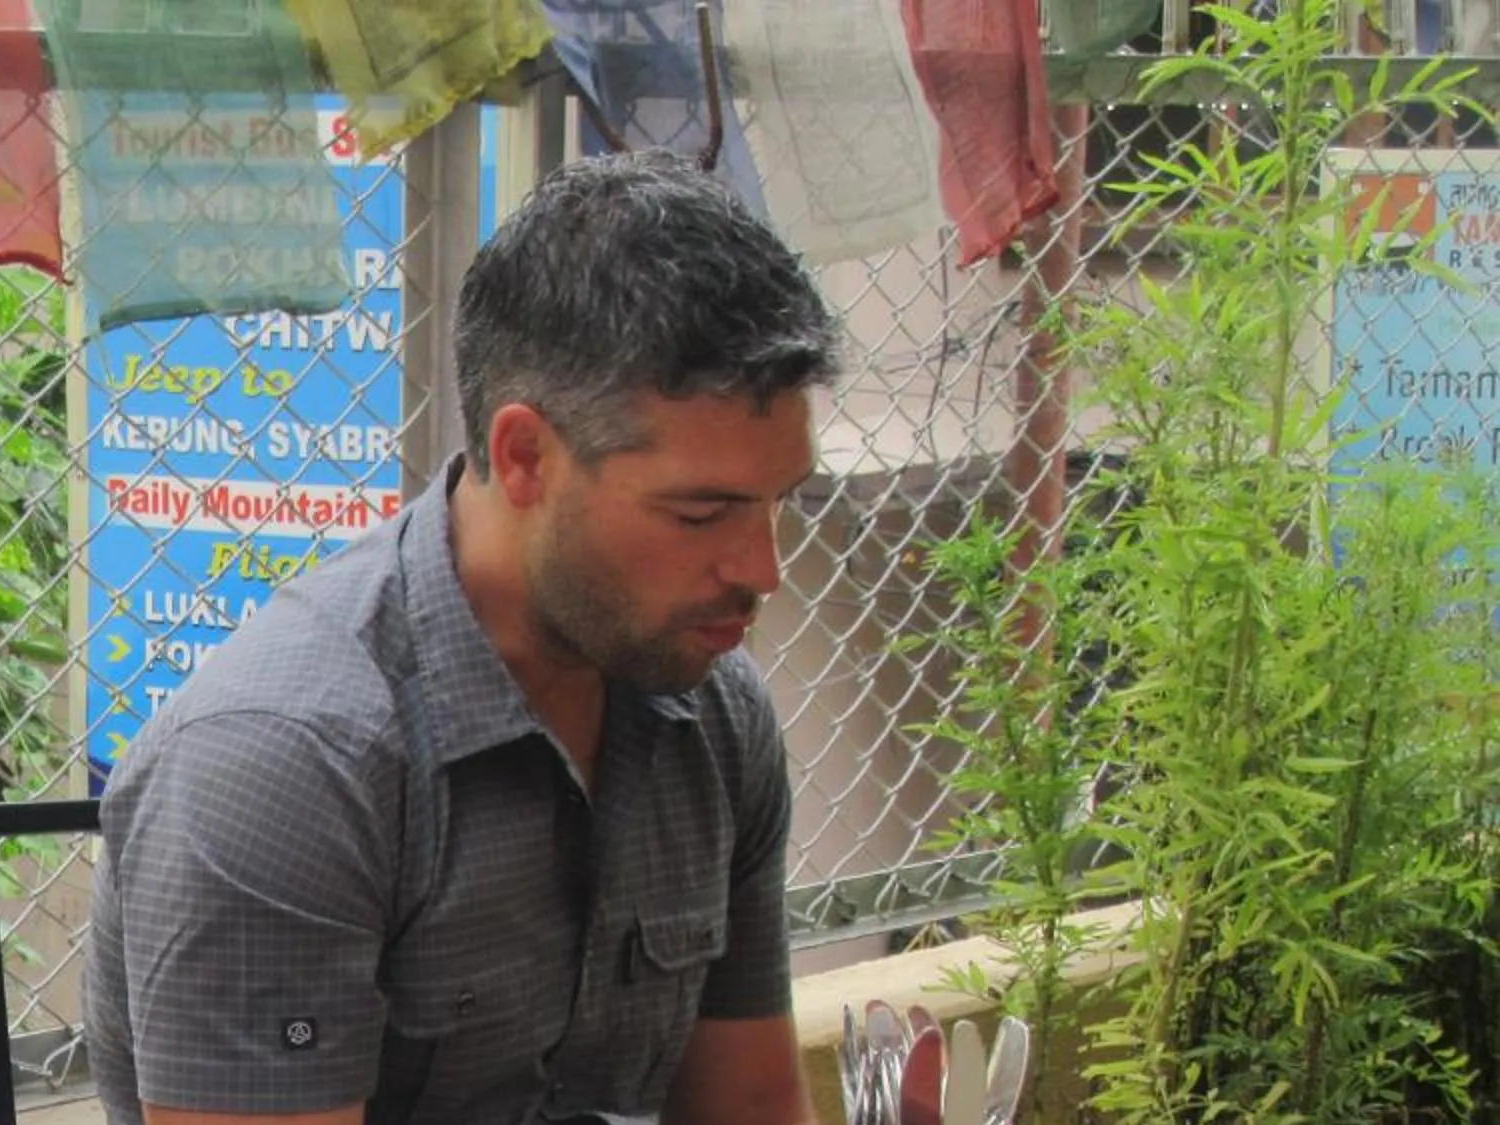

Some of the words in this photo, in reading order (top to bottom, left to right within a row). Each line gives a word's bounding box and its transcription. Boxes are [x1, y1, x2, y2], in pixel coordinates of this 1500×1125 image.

[223, 310, 402, 352] CHITW
[112, 355, 221, 405] Jeep
[241, 364, 294, 397] to
[107, 478, 192, 525] Daily
[201, 484, 369, 529] Mountain
